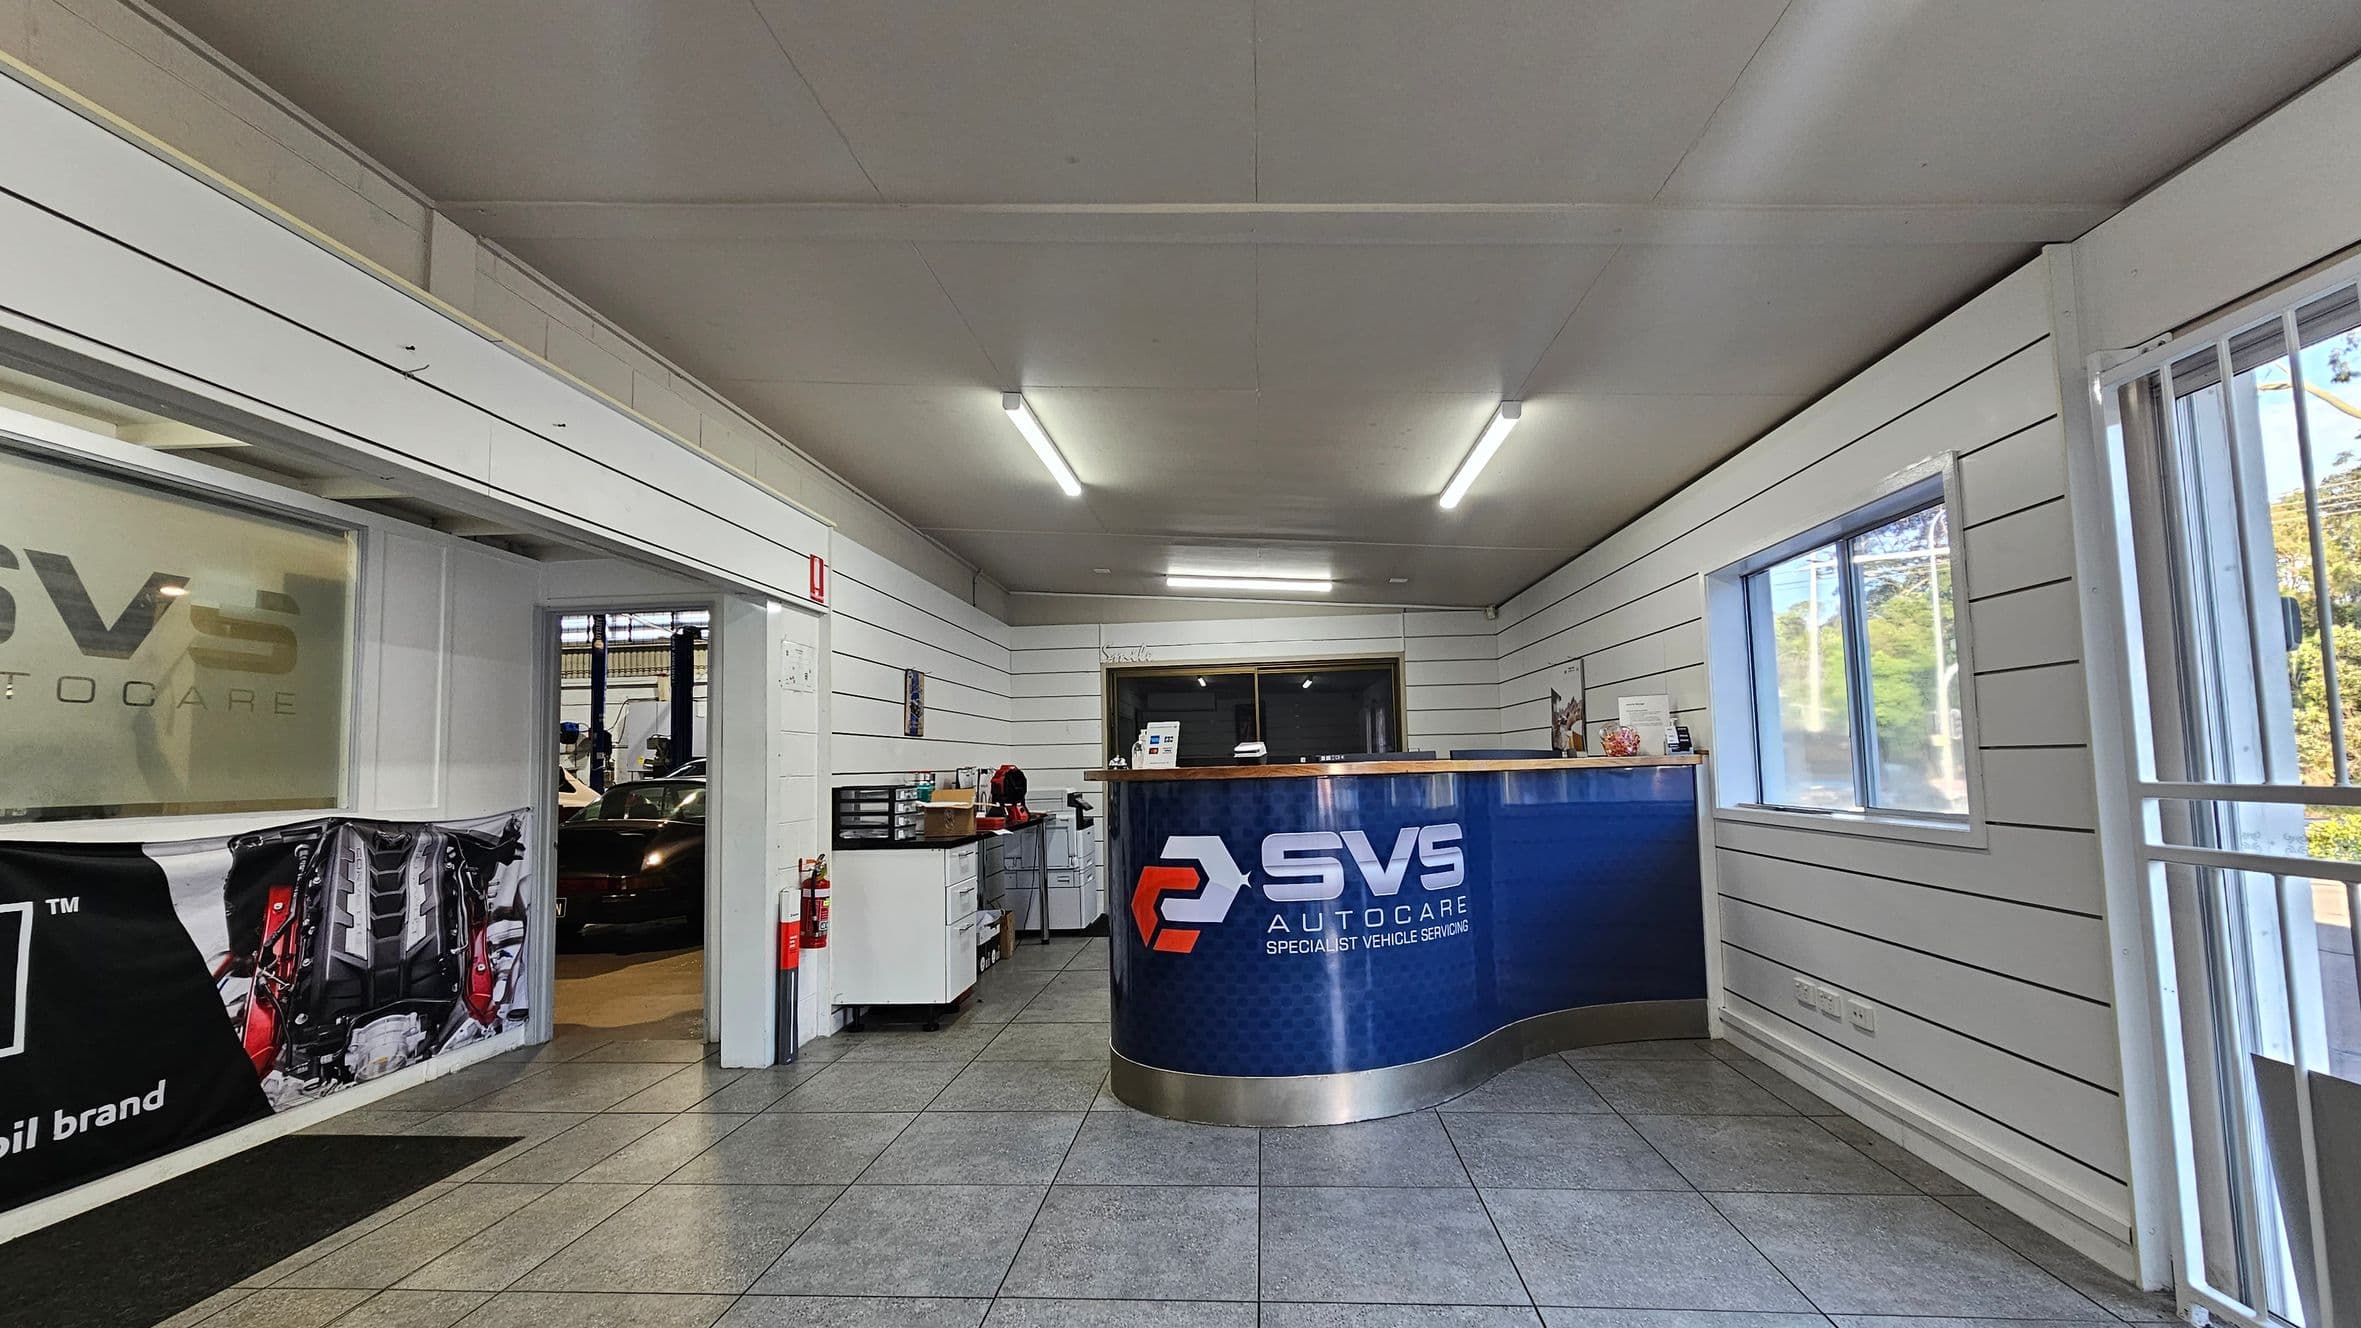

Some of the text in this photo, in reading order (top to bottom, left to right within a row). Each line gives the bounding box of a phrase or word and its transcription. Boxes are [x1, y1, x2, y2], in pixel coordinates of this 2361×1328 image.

[0, 543, 301, 675] VS
[1261, 822, 1465, 902] SVS
[45, 896, 80, 915] TM
[1267, 895, 1467, 934] AUTOCARE
[1266, 919, 1469, 955] SPECIALIST VEHICLE SERVICING
[53, 1079, 166, 1141] brand
